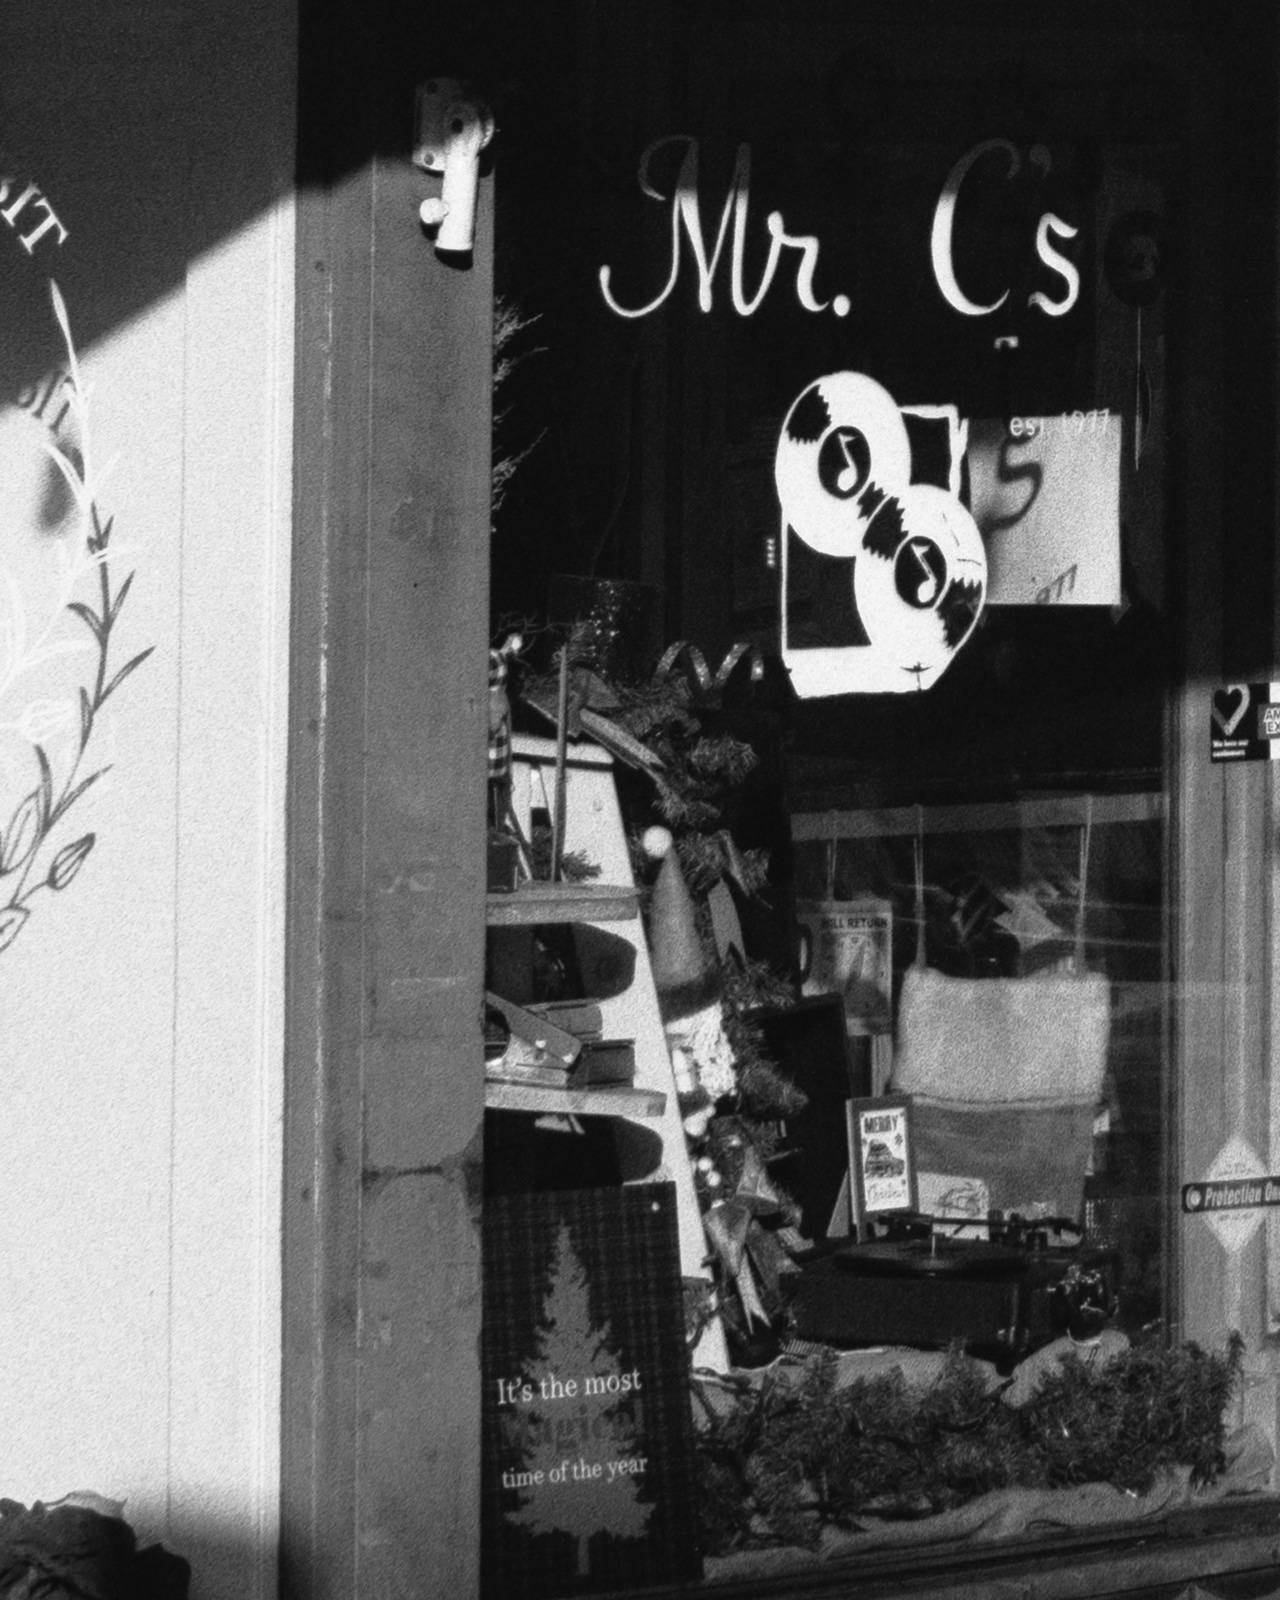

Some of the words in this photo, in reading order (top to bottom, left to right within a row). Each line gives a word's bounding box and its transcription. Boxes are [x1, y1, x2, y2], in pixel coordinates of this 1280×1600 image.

[600, 133, 852, 319] Mr.
[930, 137, 1080, 317] C's
[847, 916, 888, 929] RETURN
[863, 1114, 899, 1134] MERRY
[1204, 1183, 1263, 1208] Protection
[496, 1376, 533, 1406] It's
[540, 1372, 578, 1401] the
[584, 1367, 643, 1396] most
[501, 1466, 545, 1490] time
[548, 1459, 570, 1483] of
[572, 1458, 603, 1481] the
[606, 1458, 649, 1484] year
